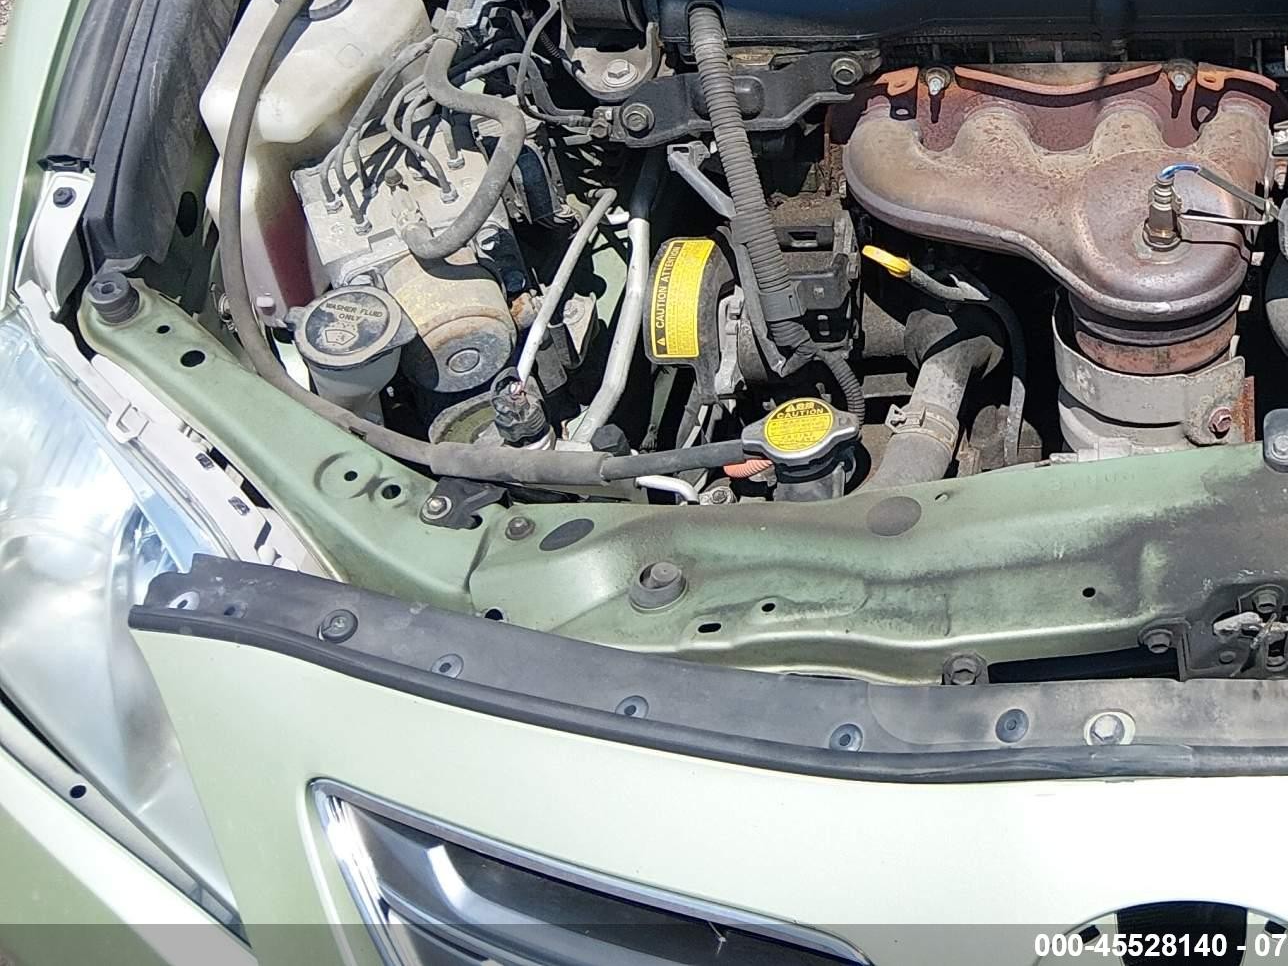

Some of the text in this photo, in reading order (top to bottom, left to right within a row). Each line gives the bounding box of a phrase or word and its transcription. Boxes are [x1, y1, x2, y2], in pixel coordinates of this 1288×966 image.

[656, 246, 681, 329] CAUTION ATTENTION
[325, 302, 383, 318] WASHER FLUID
[338, 313, 362, 321] ONLY
[776, 408, 824, 420] CAUTION
